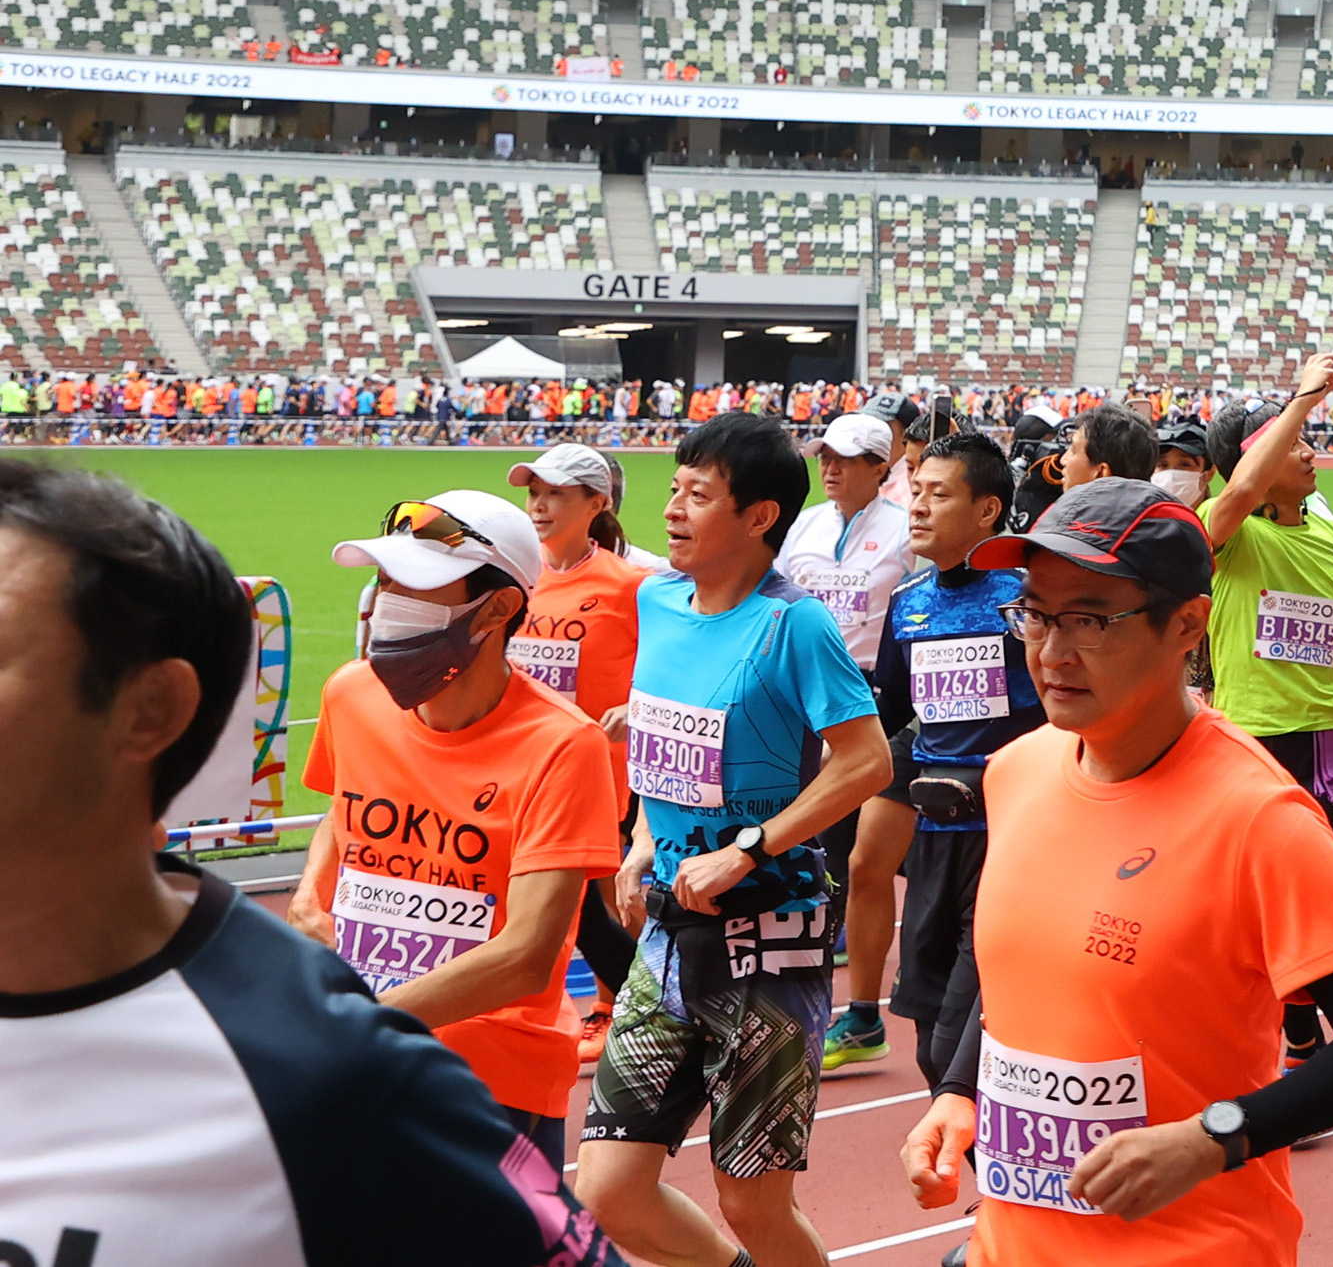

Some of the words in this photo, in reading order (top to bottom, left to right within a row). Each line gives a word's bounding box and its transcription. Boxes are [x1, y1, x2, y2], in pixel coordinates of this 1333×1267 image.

[10, 62, 74, 79] TOKYO
[80, 66, 150, 83] LEGACY
[154, 71, 200, 85] HALF
[206, 73, 252, 88] 2022
[517, 88, 576, 103] TOKYO
[581, 91, 645, 106] LEGACY
[650, 94, 692, 107] HALF
[698, 96, 740, 109] 2022
[987, 105, 1043, 119] TOKYO
[1048, 107, 1108, 120] LEGACY
[1113, 109, 1152, 122] HALF
[1157, 110, 1197, 123] 2022
[583, 274, 669, 301] GATE
[680, 275, 701, 300] 4
[833, 575, 867, 586] 2022
[1280, 598, 1310, 609] TOKYO
[526, 614, 586, 641] KYO
[903, 623, 929, 632] PENALTY
[532, 645, 576, 661] 2022
[926, 648, 955, 658] TOKYO
[956, 644, 1001, 662] 2022
[915, 669, 989, 698] B12628
[643, 703, 672, 720] TOKYO
[672, 712, 720, 739] 2022
[629, 728, 706, 776] B13900
[342, 791, 489, 864] TOKYO
[351, 900, 379, 914] LEGACY
[381, 904, 402, 916] HALF
[354, 884, 405, 905] TOKYO
[406, 894, 488, 928] 2022
[1093, 911, 1142, 934] TOKYO
[1089, 925, 1117, 940] LEGACY
[1118, 931, 1137, 945] HALF
[1085, 936, 1137, 965] 2022
[992, 1077, 1018, 1095] LEGACY
[1019, 1081, 1041, 1097] HALF
[994, 1056, 1041, 1084] TOKYO
[1045, 1071, 1138, 1106] 2022
